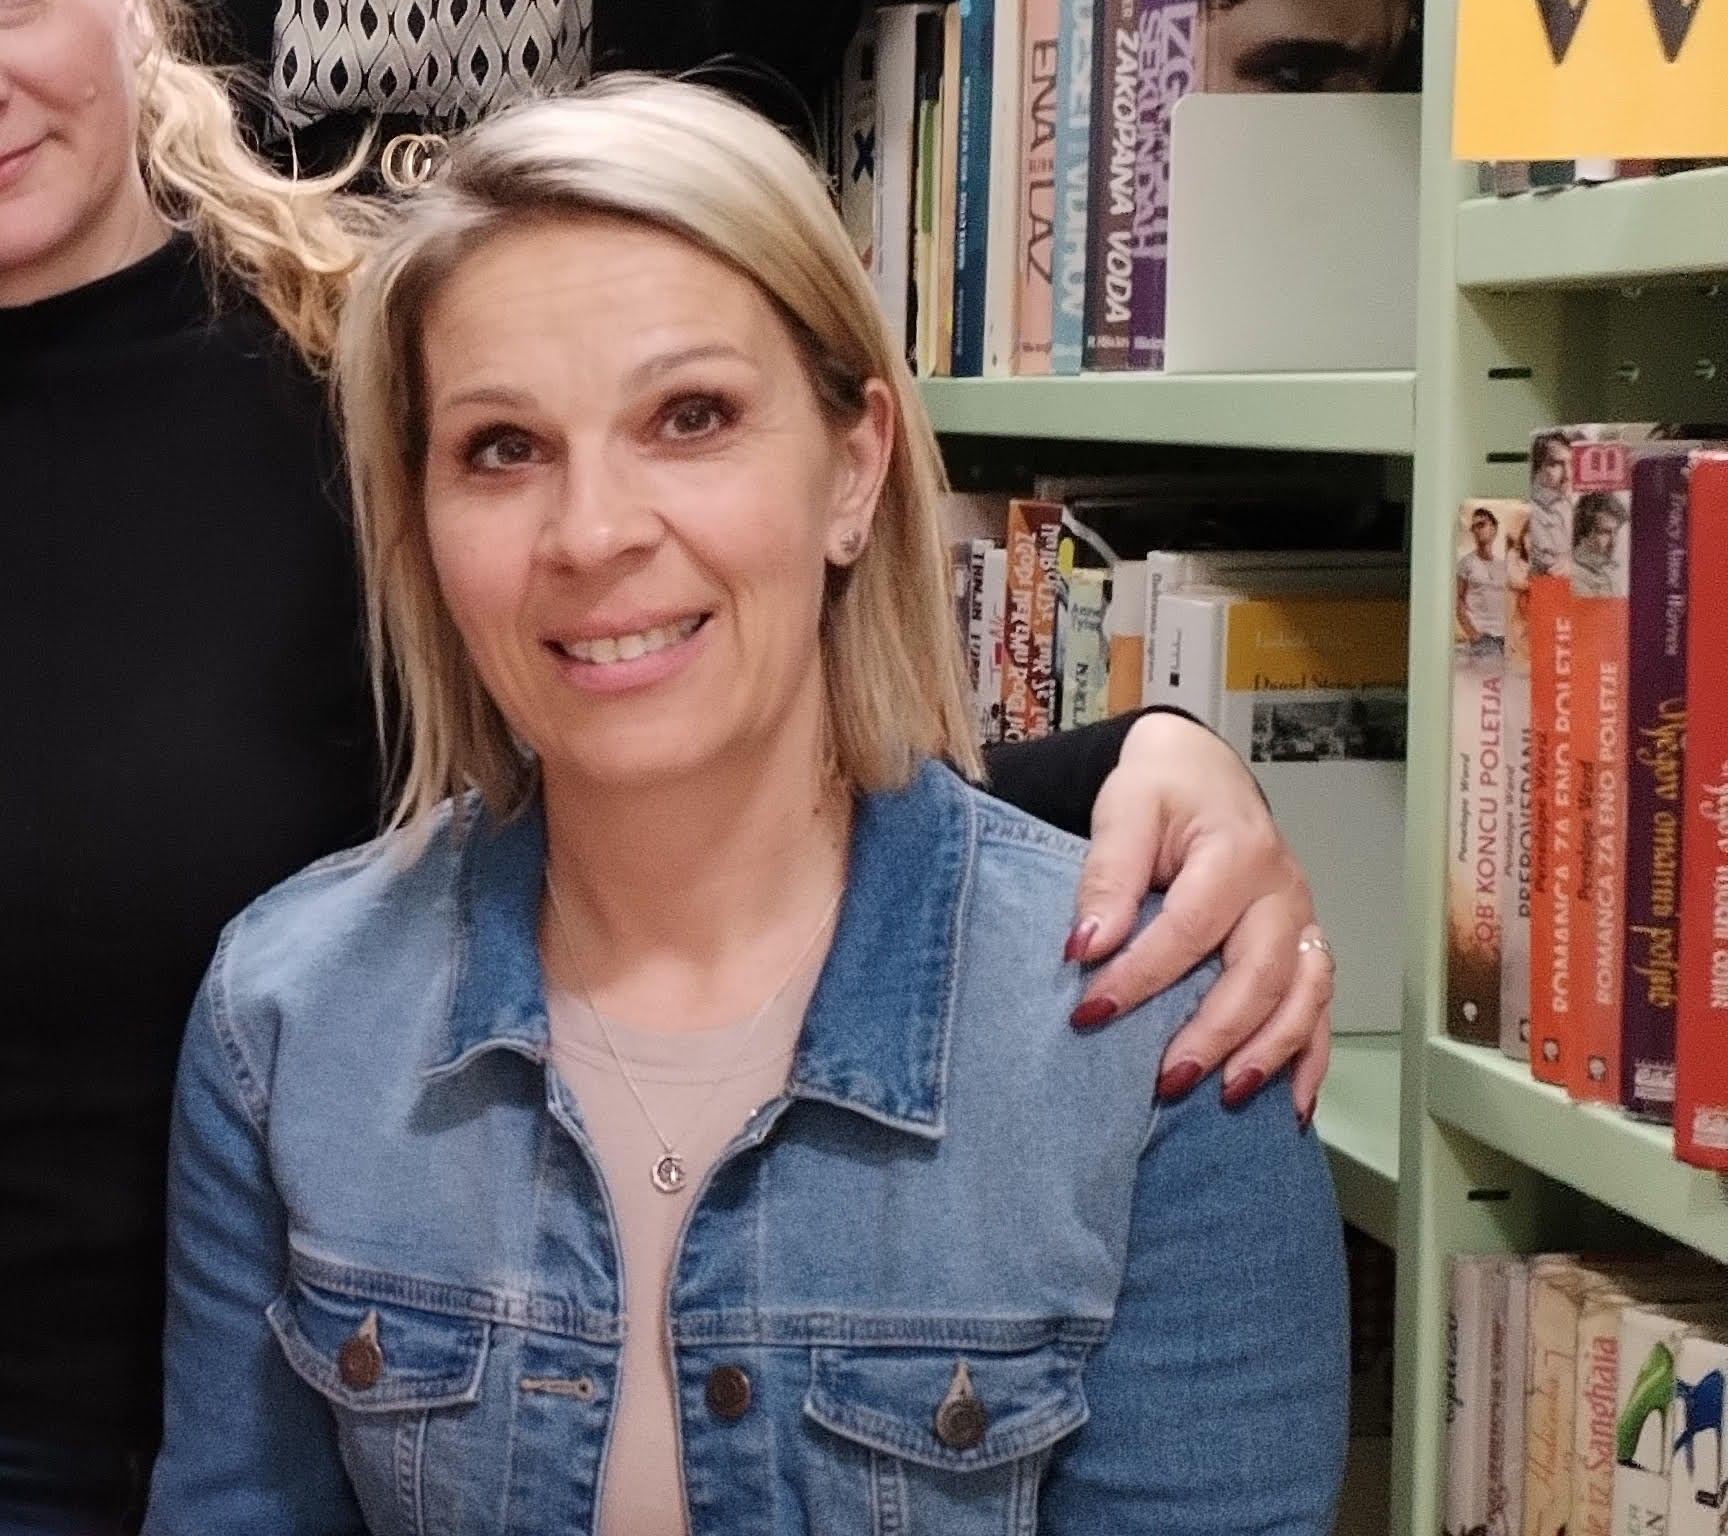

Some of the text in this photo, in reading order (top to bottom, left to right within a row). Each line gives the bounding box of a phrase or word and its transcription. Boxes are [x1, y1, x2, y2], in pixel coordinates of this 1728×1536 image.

[1030, 39, 1059, 152] ENA
[1104, 28, 1139, 322] ZAKOPANA VODA
[1457, 753, 1471, 863] Penelope Ward
[1475, 676, 1502, 944] OB KONCU POLETJA
[1503, 763, 1516, 877] Penelope Ward
[1534, 730, 1549, 894] Penelope Ward
[1551, 617, 1571, 1012] ROMANCA ZA ENO POLETJE
[1575, 759, 1593, 902] Penelope Ward
[1596, 661, 1618, 1005] ROMANCA ZA ENO POLETJE
